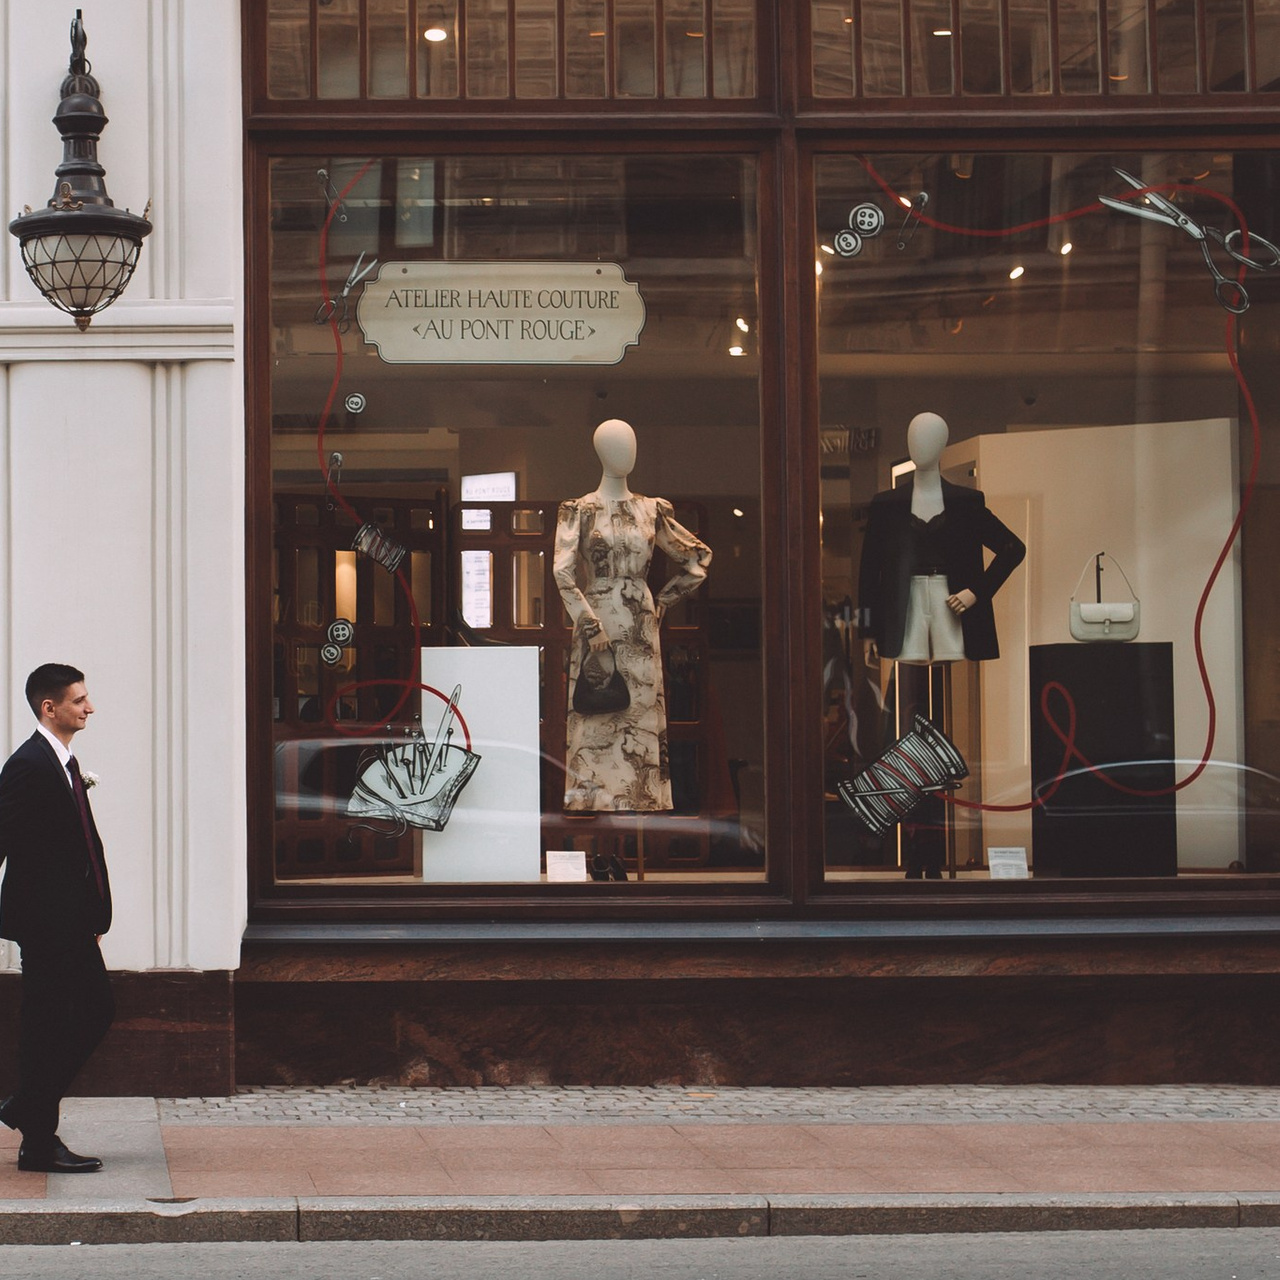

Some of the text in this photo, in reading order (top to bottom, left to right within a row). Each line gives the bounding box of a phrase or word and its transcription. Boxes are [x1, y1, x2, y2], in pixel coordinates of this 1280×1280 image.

[384, 289, 620, 309] ATELIER HAUTE COUTURE
[459, 319, 514, 339] PONT
